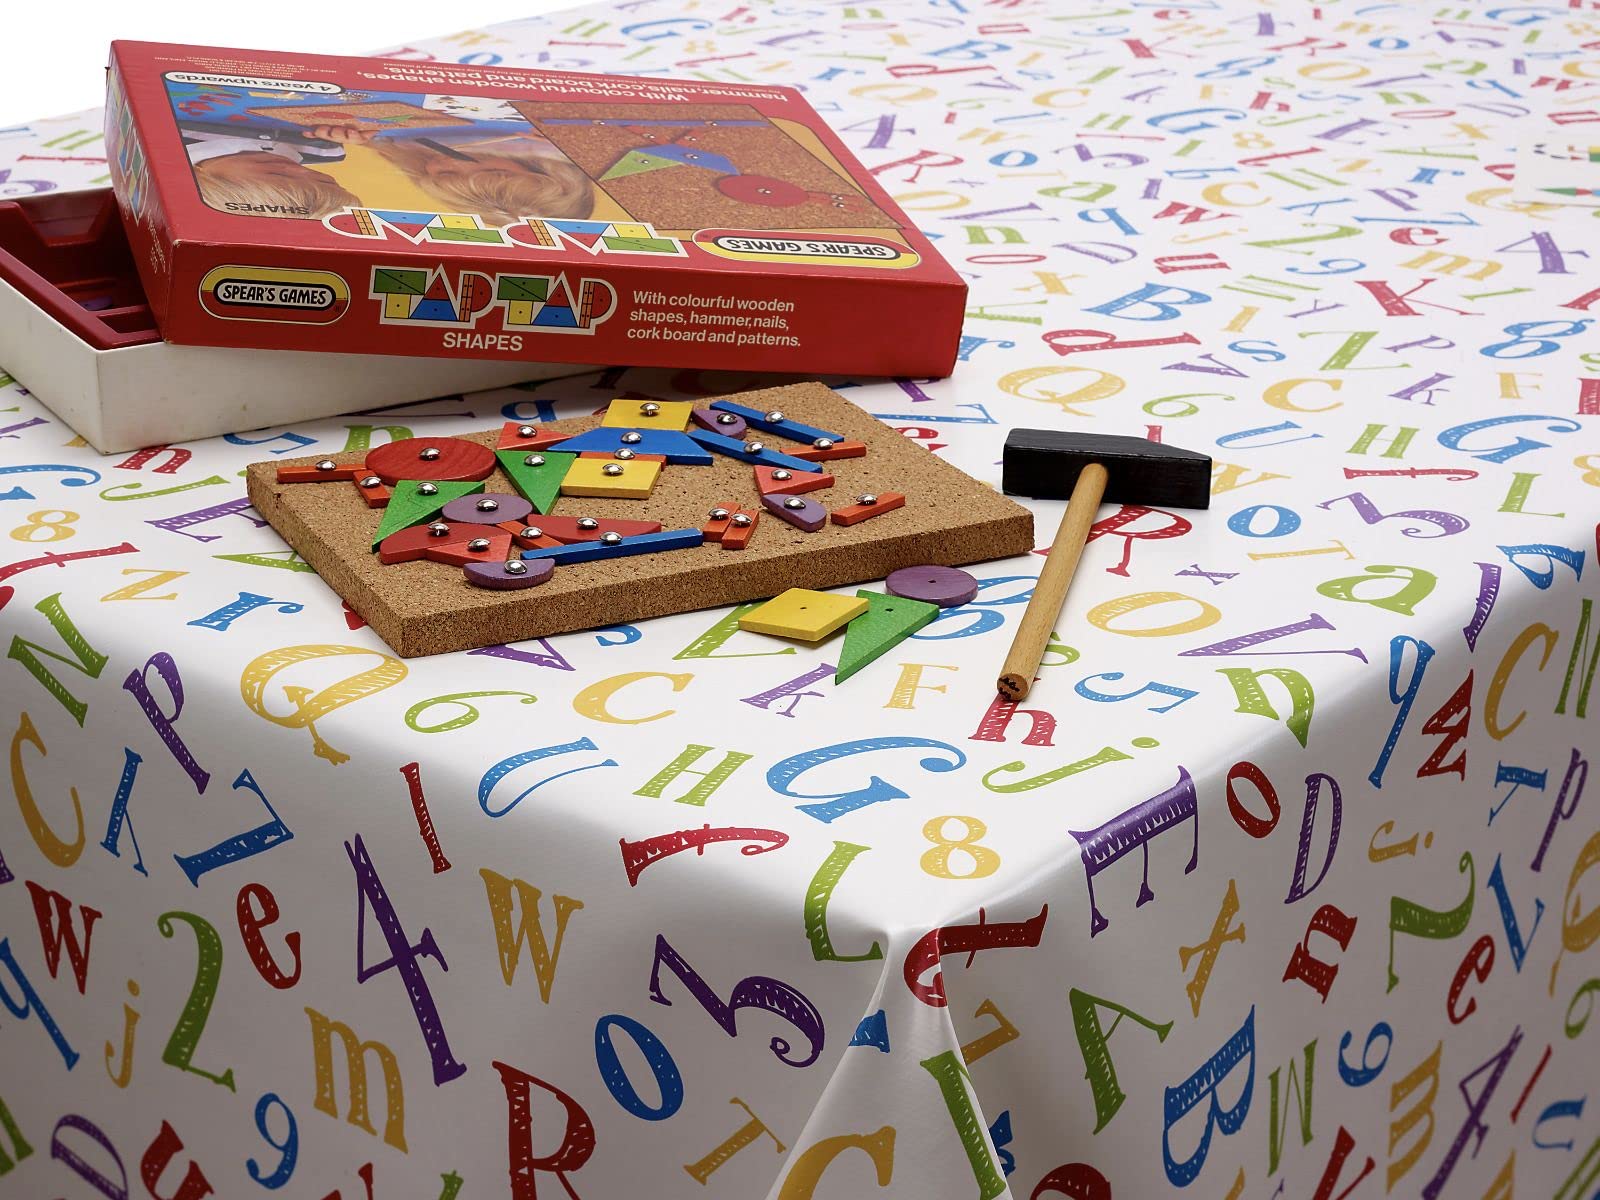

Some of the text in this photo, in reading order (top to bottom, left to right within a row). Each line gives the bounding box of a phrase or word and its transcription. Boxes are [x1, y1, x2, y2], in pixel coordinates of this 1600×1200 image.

[174, 73, 258, 86] upwards
[261, 81, 313, 90] years
[357, 70, 447, 84] shapes,
[383, 66, 479, 80] patterns.
[449, 77, 536, 90] wooden
[482, 73, 530, 83] and
[531, 76, 596, 89] board
[540, 81, 637, 98] colourful
[639, 90, 690, 102] With
[225, 202, 310, 215] SHAPES
[726, 238, 888, 256] SPEAR'S GAMES
[1389, 227, 1450, 246] e
[222, 284, 327, 305] SPEAR'S GAMES
[629, 308, 688, 325] shapes,
[633, 290, 795, 312] With colourful wooden
[1080, 282, 1212, 321] B
[1354, 278, 1485, 317] K
[442, 332, 523, 351] SHAPES
[627, 327, 802, 347] cork board and patterns.
[998, 366, 1126, 416] Q
[1263, 379, 1342, 412] C
[1346, 424, 1419, 459] H
[1437, 415, 1582, 464] G
[1497, 472, 1565, 518] L
[10, 510, 80, 542] 8
[186, 592, 304, 631] r
[7, 592, 109, 728] N
[1484, 622, 1560, 741] C
[240, 644, 409, 766] Q
[572, 672, 694, 725] C
[882, 662, 960, 710] F
[1074, 672, 1200, 713] 5
[123, 652, 211, 795] p
[404, 691, 538, 733] 6
[10, 711, 86, 868] C
[478, 737, 619, 818] U
[632, 744, 753, 807] H
[766, 737, 967, 824] G
[1530, 747, 1588, 873] p
[920, 816, 1001, 879] 8
[1284, 773, 1342, 904] D
[804, 841, 884, 962] L
[236, 883, 301, 989] e
[344, 833, 467, 1087] 4
[157, 910, 237, 1094] 2
[649, 934, 825, 1068] 3
[1446, 934, 1496, 1025] e
[104, 979, 141, 1089] j
[304, 1006, 409, 1154] m
[1069, 987, 1174, 1136] A
[1162, 1004, 1255, 1188] B
[1421, 1025, 1524, 1200] 4
[246, 1092, 299, 1190] 9
[492, 1060, 596, 1200] R
[50, 1114, 129, 1200] D
